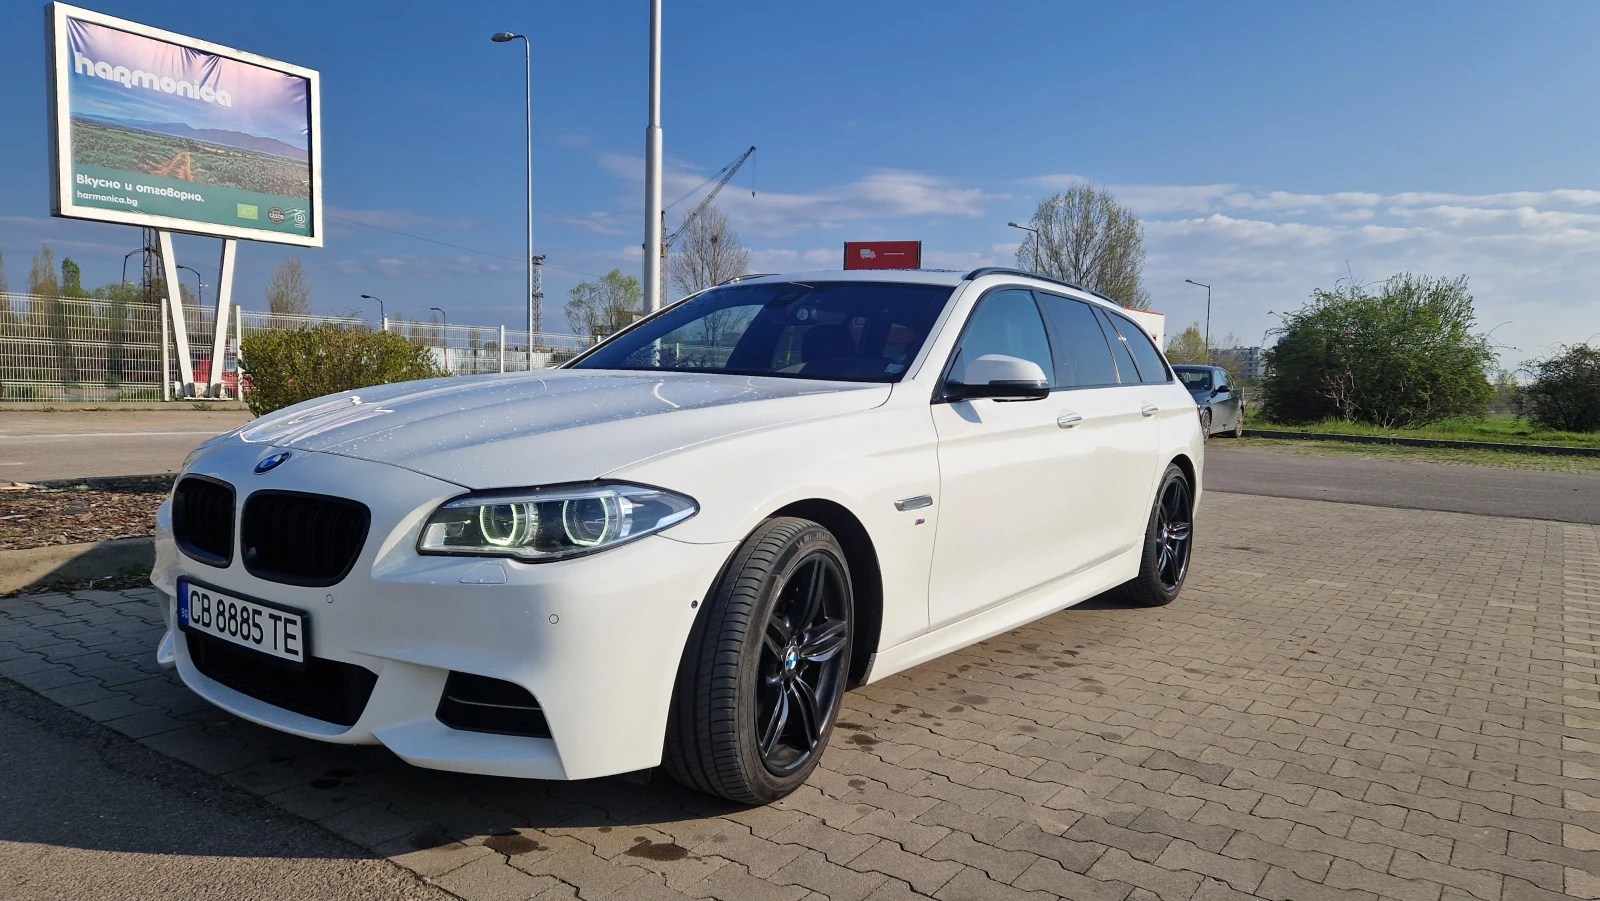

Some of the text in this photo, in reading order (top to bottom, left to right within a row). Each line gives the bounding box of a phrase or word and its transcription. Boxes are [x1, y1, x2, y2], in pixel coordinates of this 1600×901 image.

[74, 51, 232, 107] harmonica
[76, 174, 205, 202] Вкусно и отговорно.
[76, 190, 138, 207] harmonica.bg
[190, 590, 299, 656] CB 8885 TE
